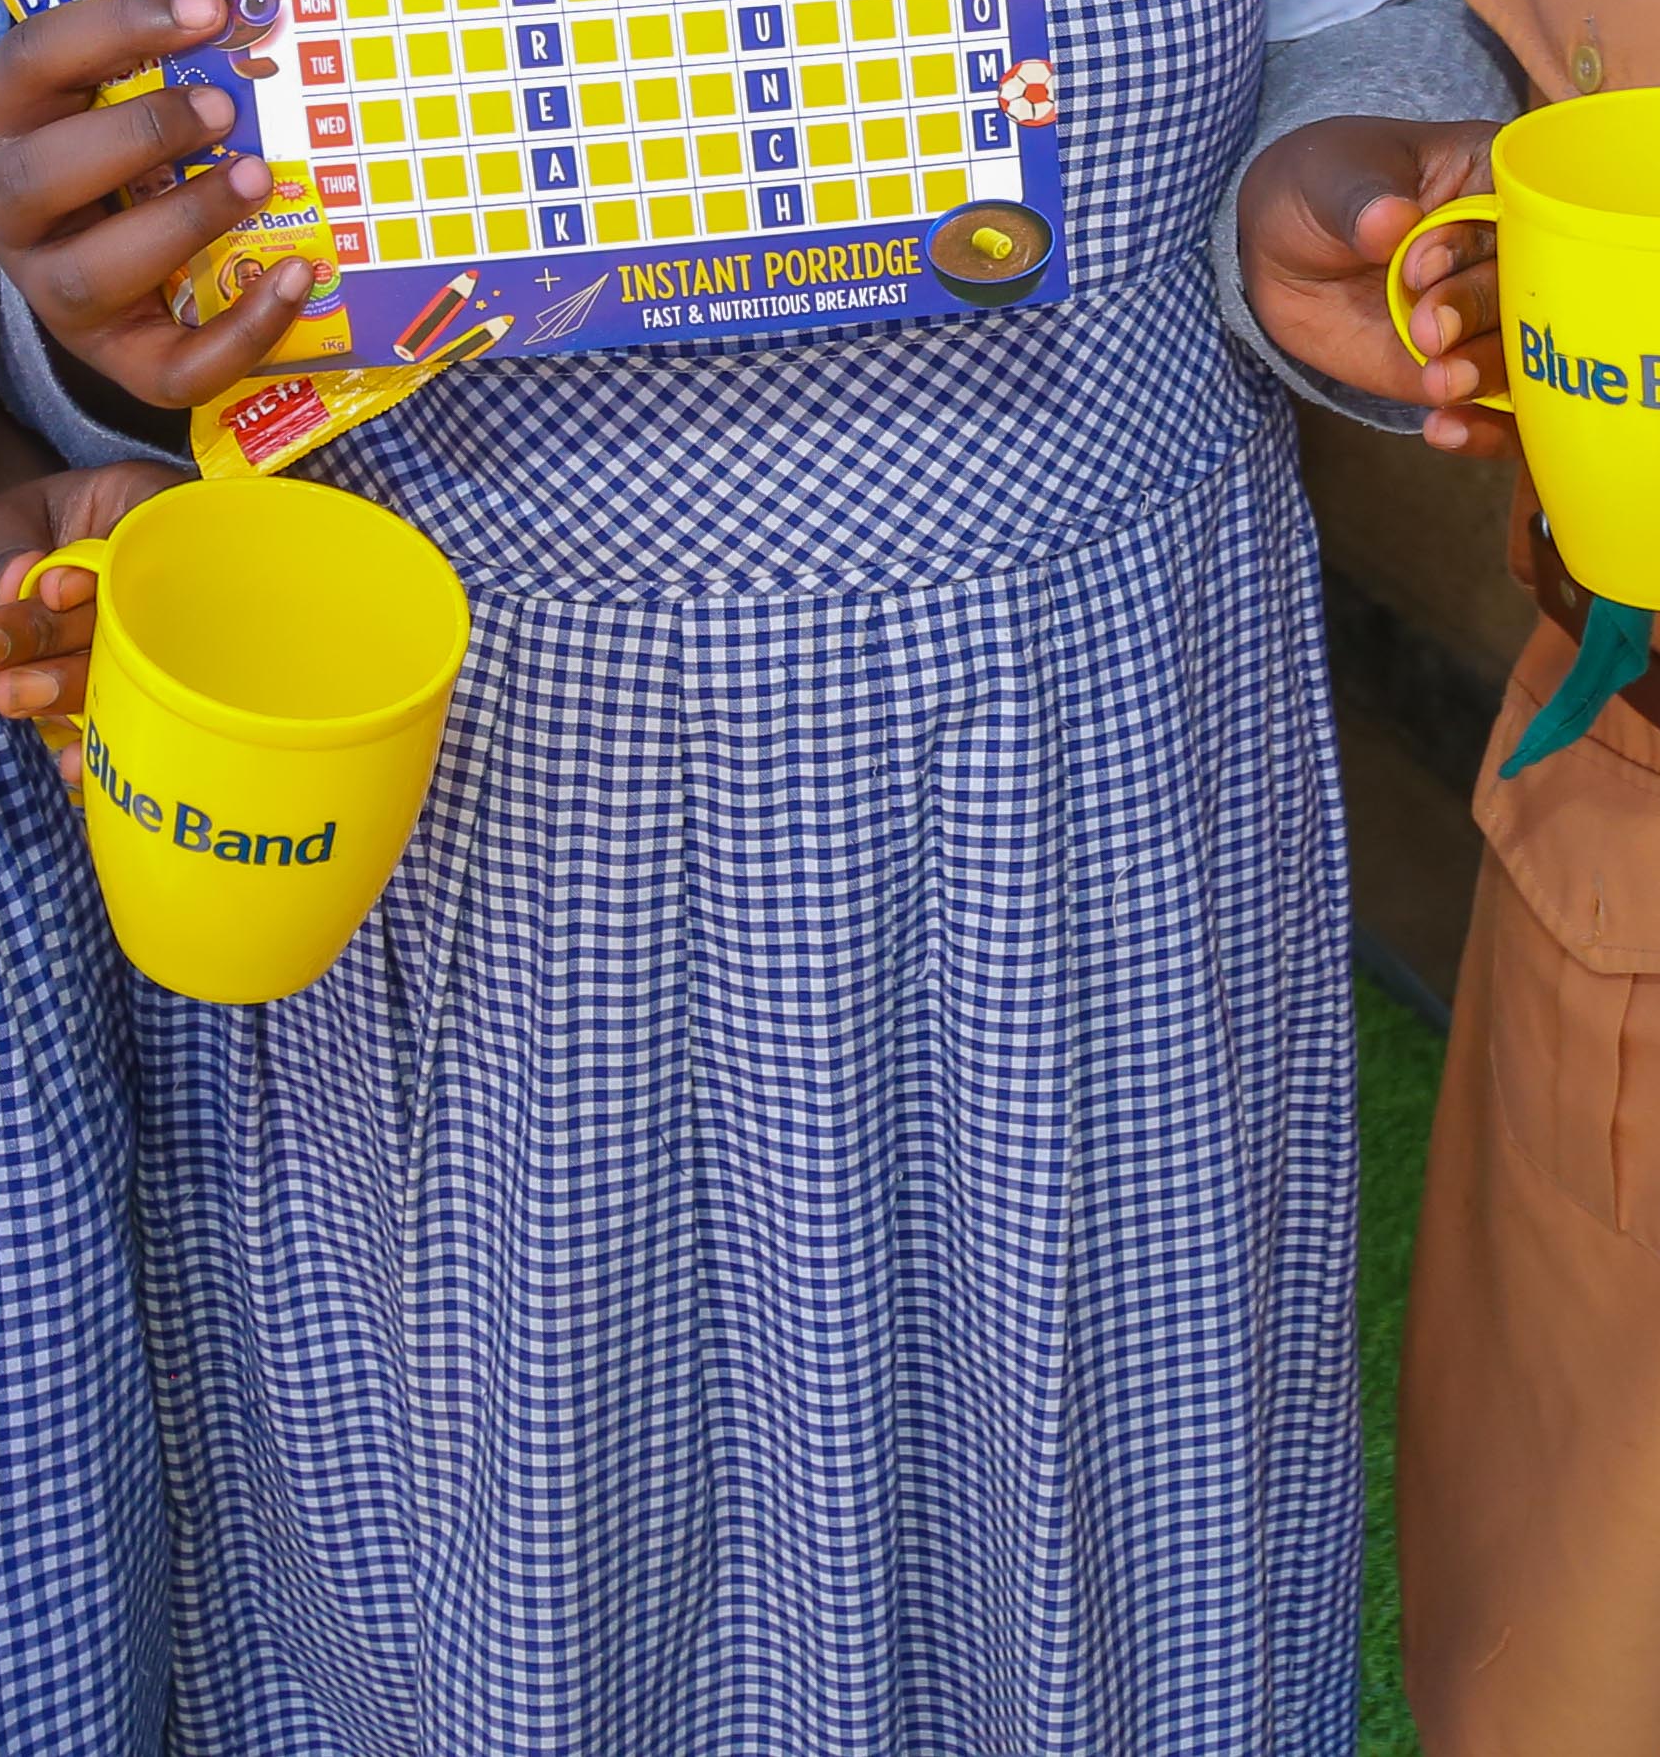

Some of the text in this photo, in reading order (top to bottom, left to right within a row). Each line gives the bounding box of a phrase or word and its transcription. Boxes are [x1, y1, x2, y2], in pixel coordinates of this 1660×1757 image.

[309, 55, 337, 76] TUE
[316, 116, 346, 136] WED
[321, 175, 357, 195] THUR
[261, 206, 320, 230] Band
[227, 233, 267, 248] INSTANT
[271, 227, 318, 243] PORRIDGE
[335, 233, 360, 252] FRI
[617, 237, 923, 304] INSTANT PORRIDGE
[642, 283, 908, 330] FAST & NUTRITIOUS BREAKFAST
[1519, 318, 1628, 406] Blue
[84, 716, 337, 867] Blue Band
